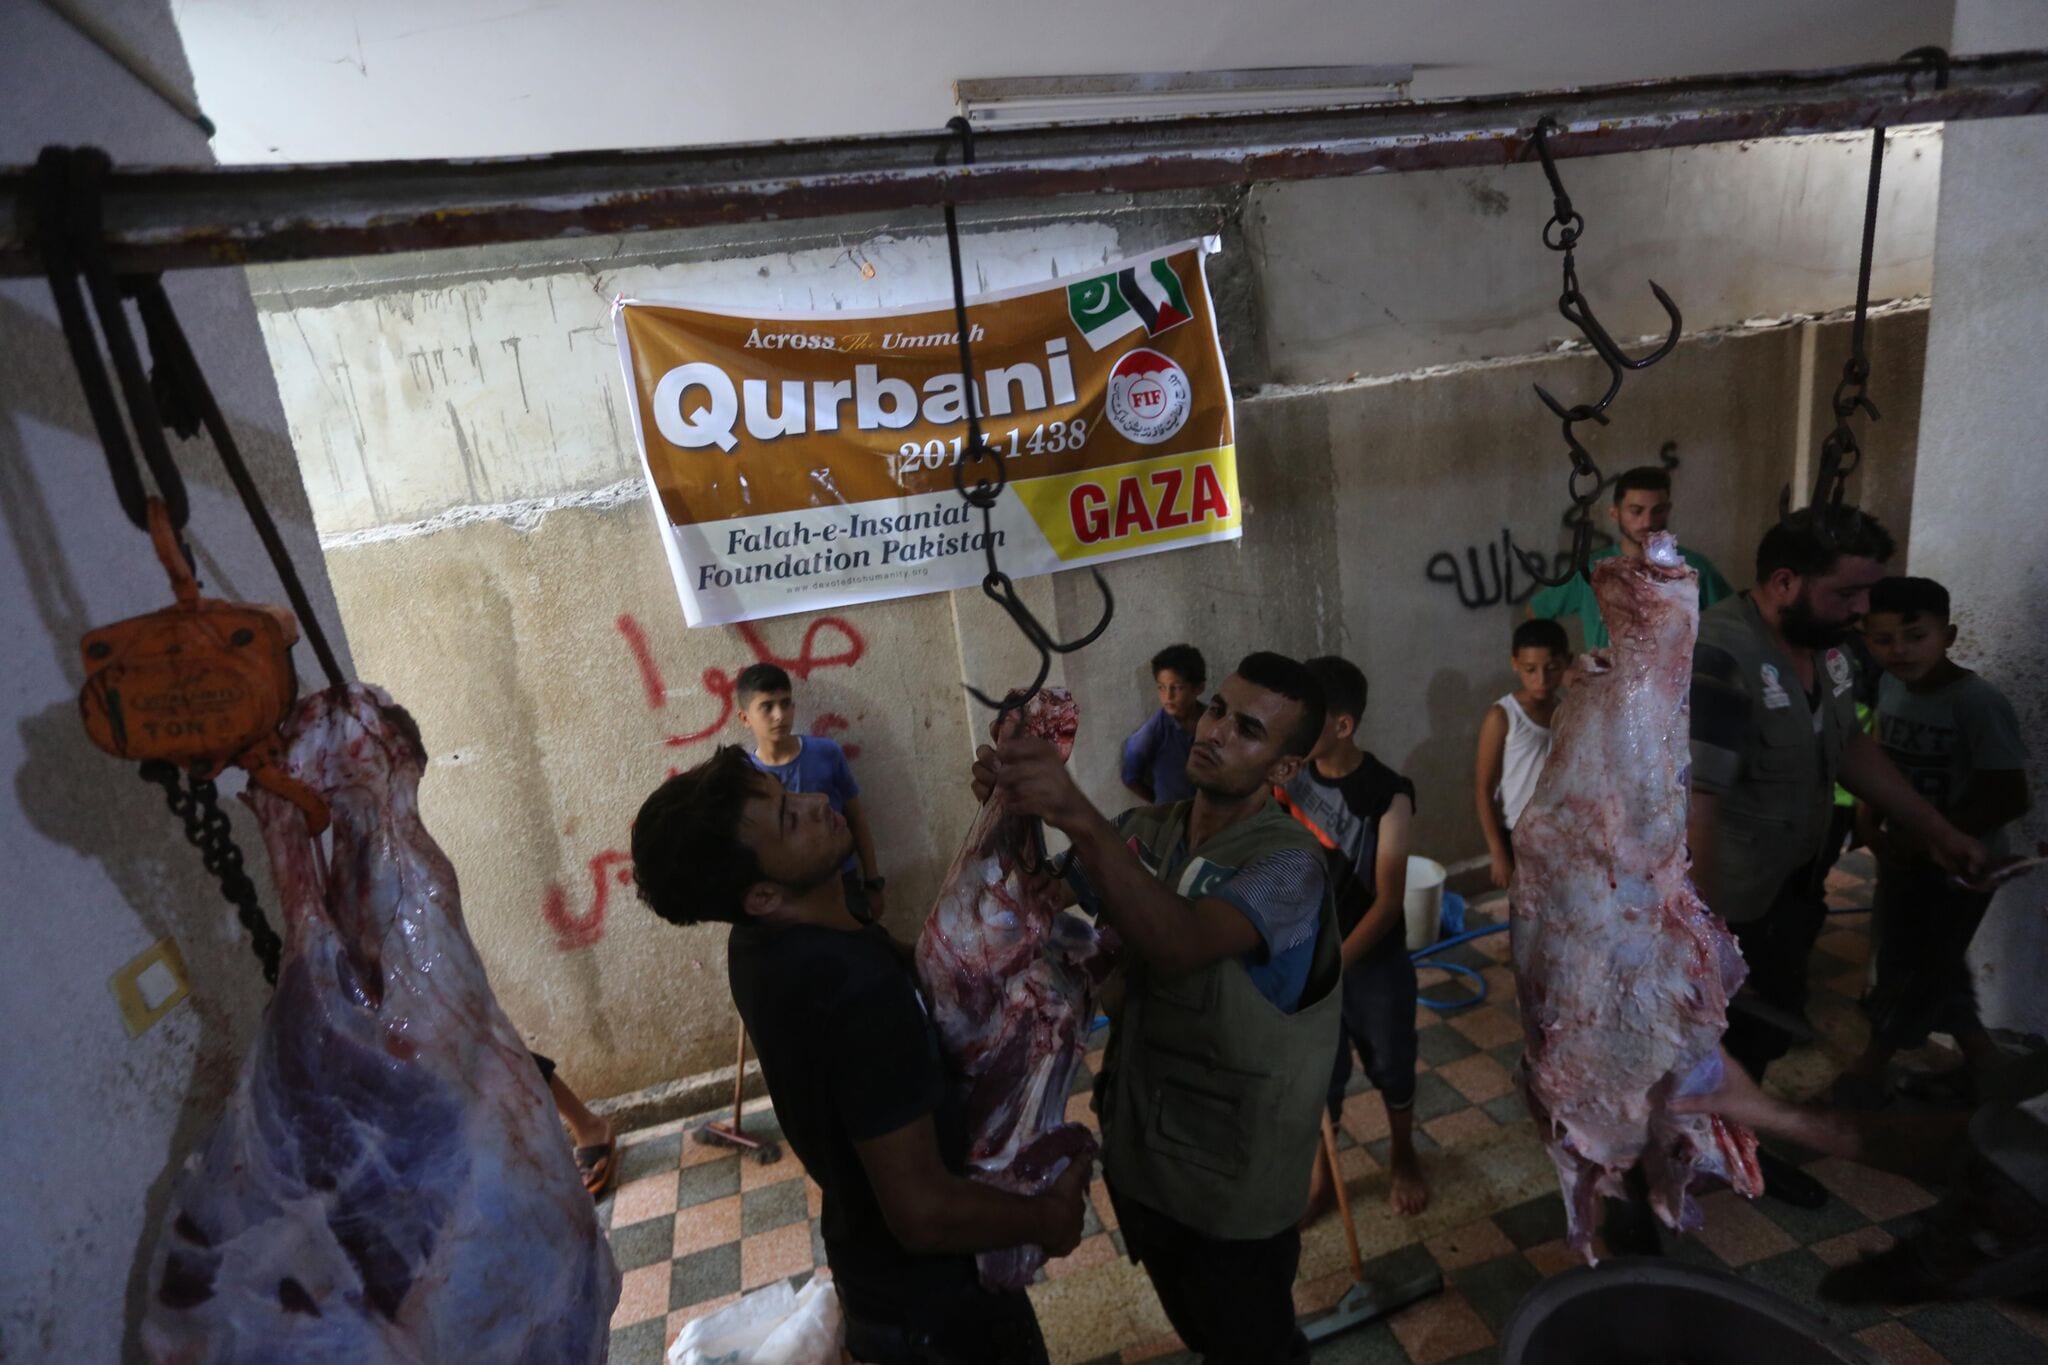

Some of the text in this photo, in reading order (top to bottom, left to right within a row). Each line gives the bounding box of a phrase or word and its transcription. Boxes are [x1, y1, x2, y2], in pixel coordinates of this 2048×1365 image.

[744, 328, 835, 350] Across
[653, 337, 1077, 454] Qurbani
[1131, 390, 1161, 408] FIF
[728, 501, 974, 555] Falah-e-Insaniat
[1069, 463, 1231, 545] GAZA
[698, 529, 1006, 590] Foundation Pakistan
